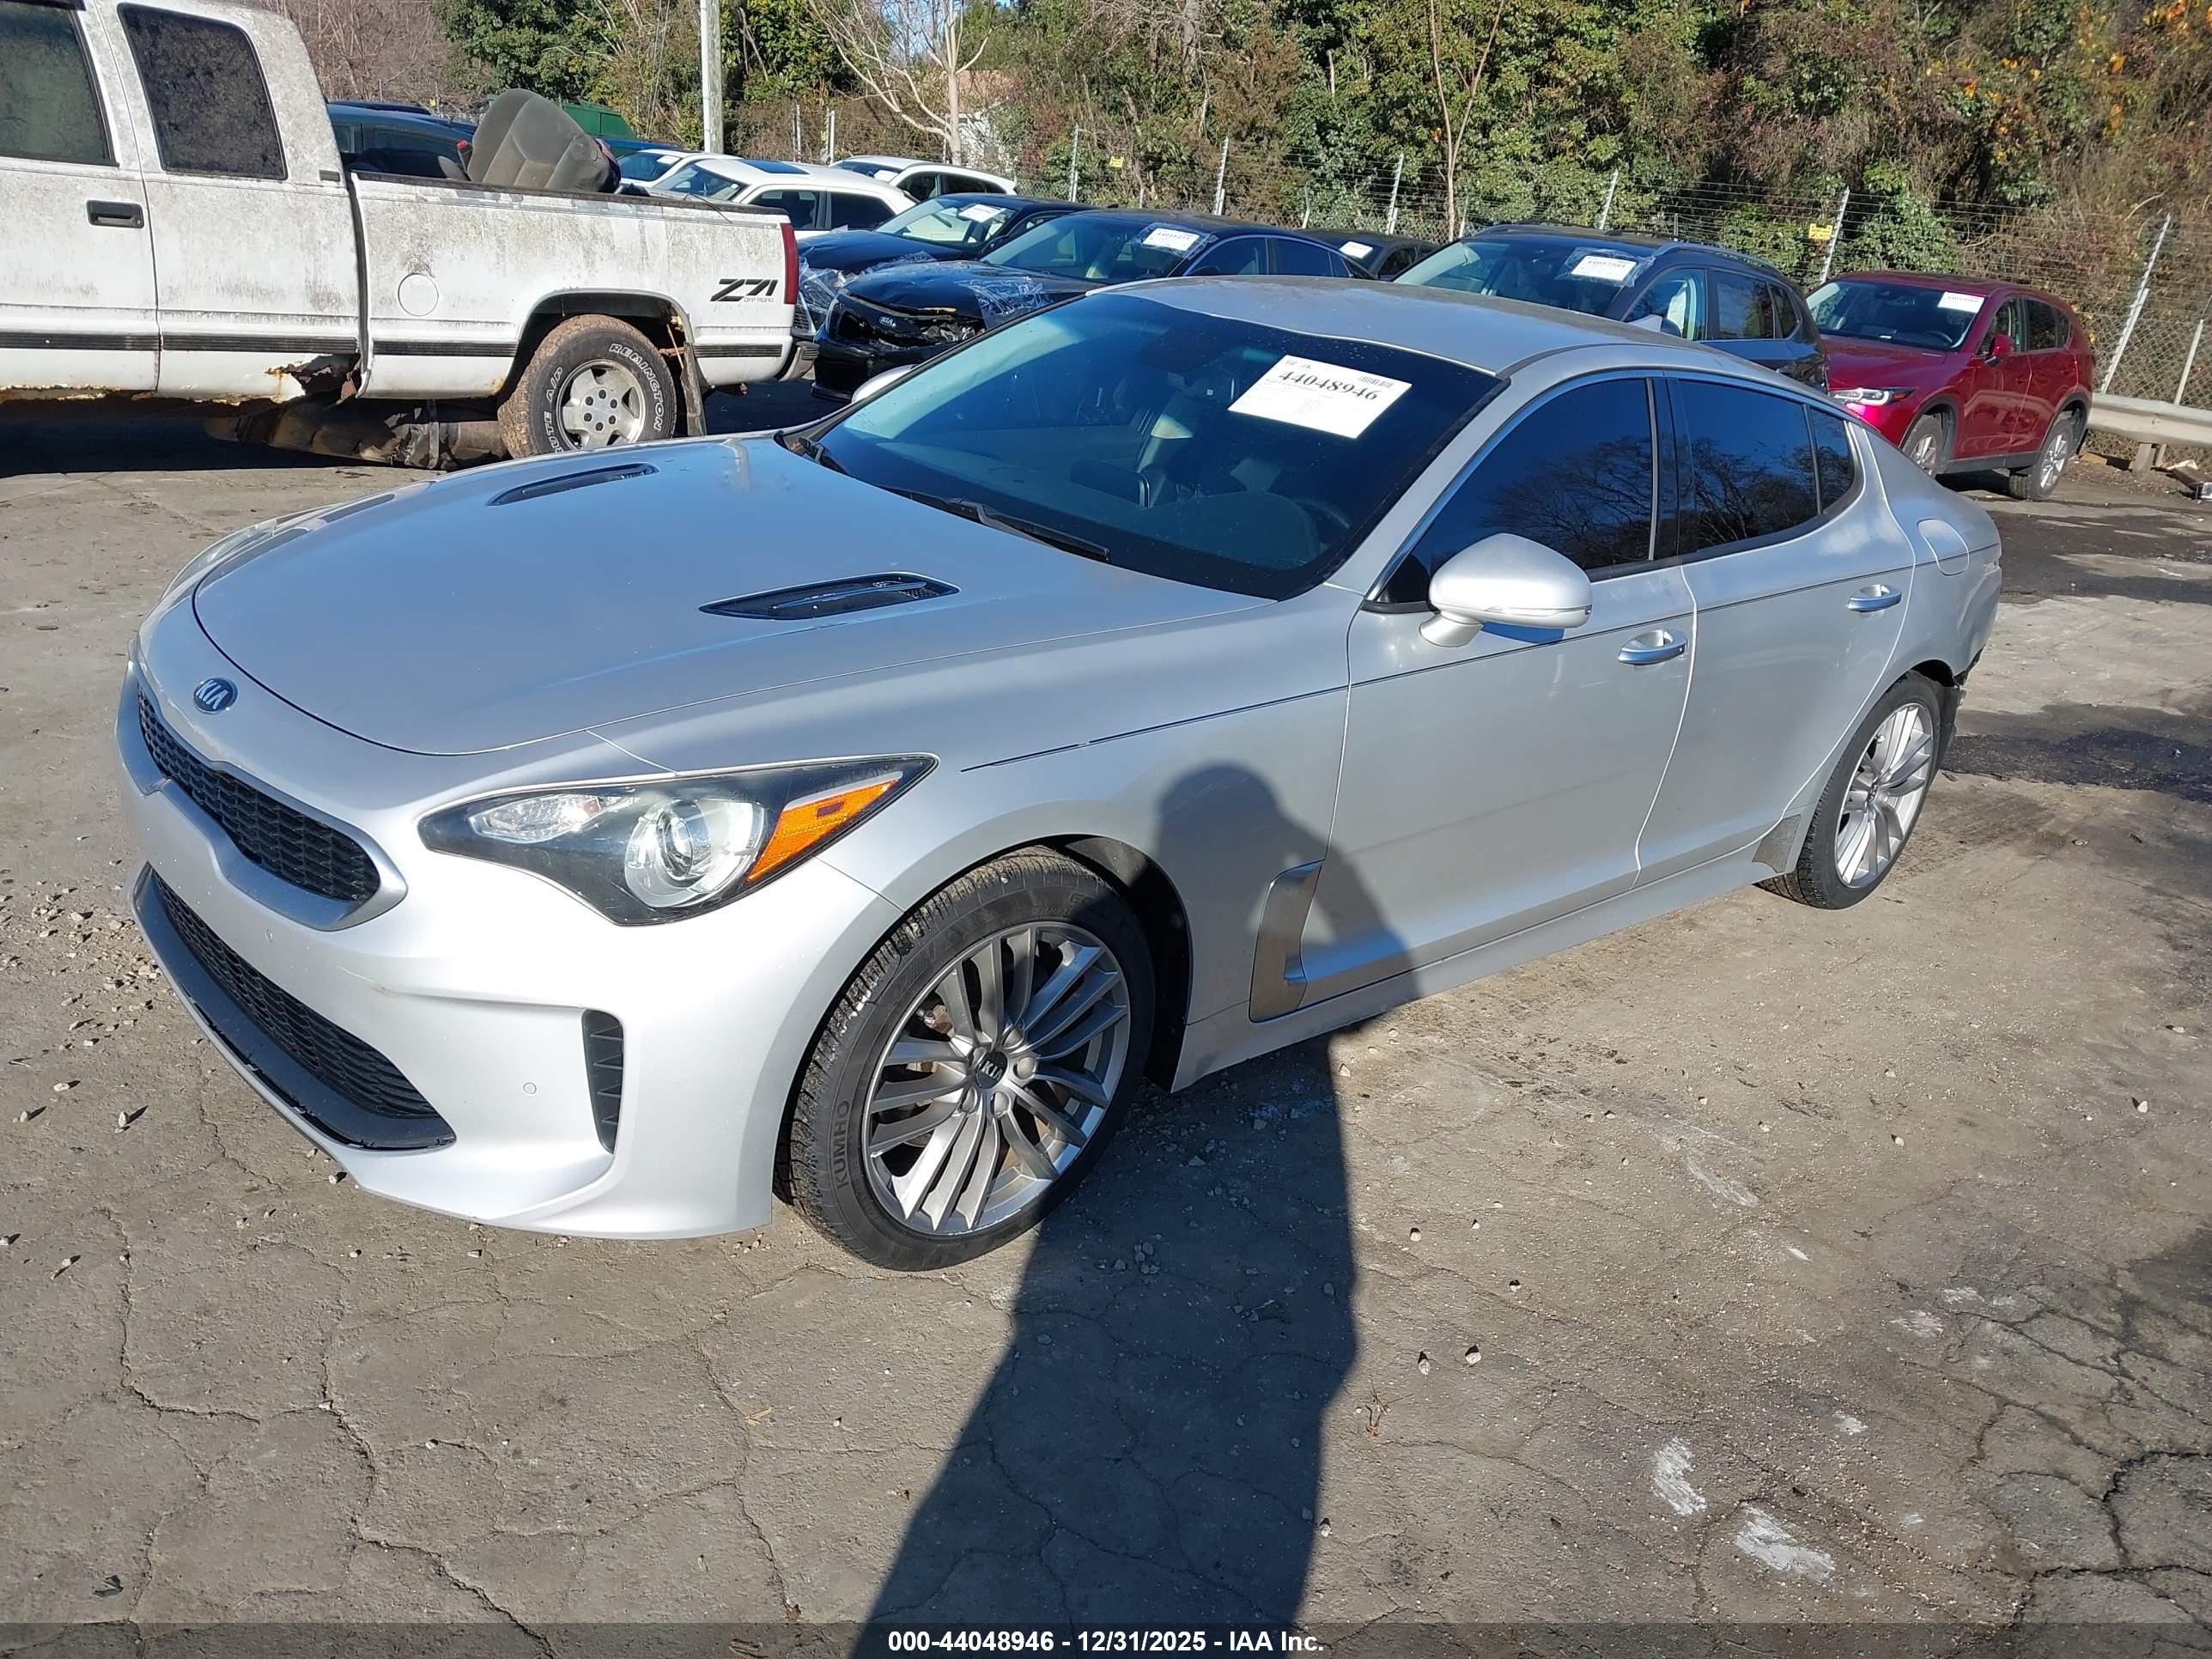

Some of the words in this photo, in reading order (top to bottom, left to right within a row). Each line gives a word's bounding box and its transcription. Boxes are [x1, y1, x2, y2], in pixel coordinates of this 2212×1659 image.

[709, 278, 779, 301] Z71
[609, 343, 665, 431] REMINGTON
[1278, 370, 1381, 401] 44048946
[195, 678, 229, 710] KIA
[981, 1060, 1004, 1081] KIA
[833, 1100, 850, 1189] KUMHO
